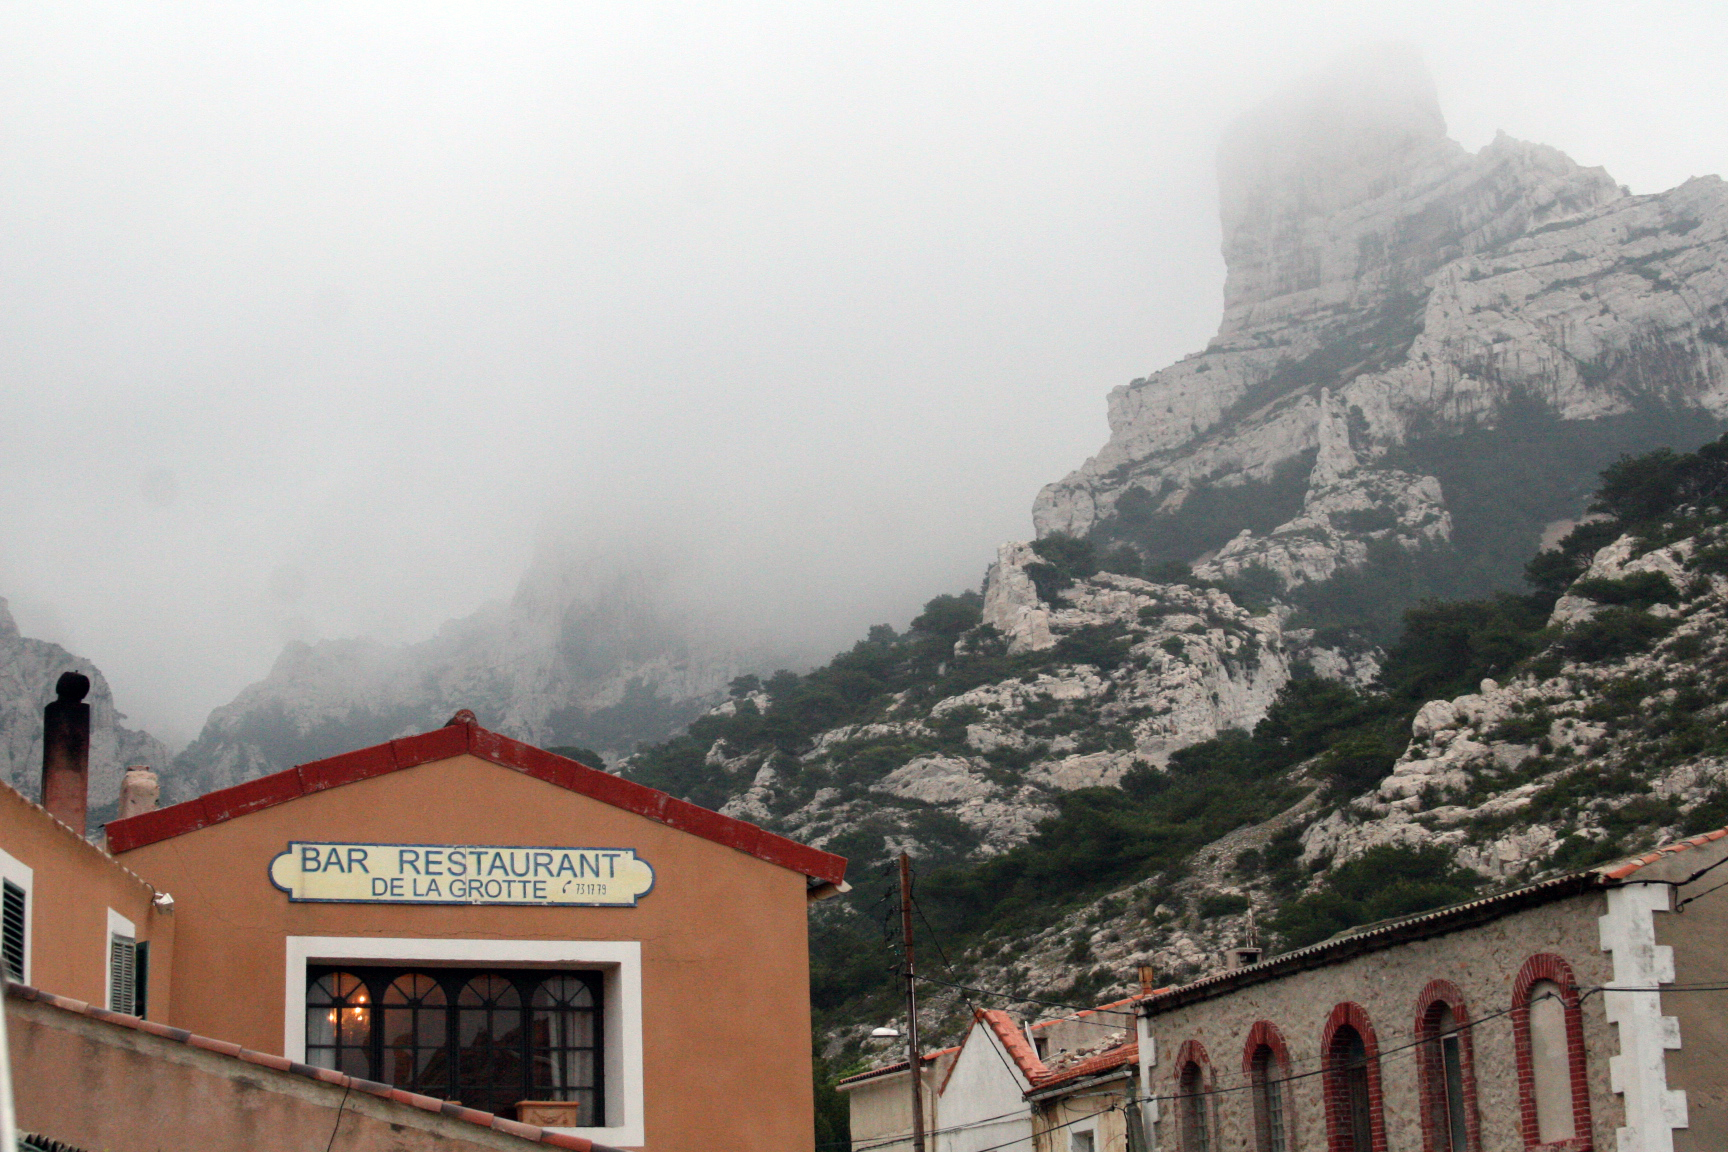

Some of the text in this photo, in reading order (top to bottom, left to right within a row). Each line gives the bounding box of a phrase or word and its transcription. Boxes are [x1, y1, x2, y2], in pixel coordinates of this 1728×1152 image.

[301, 847, 621, 878] BAR RESTAURANT
[371, 877, 547, 899] DE LA GROTTE
